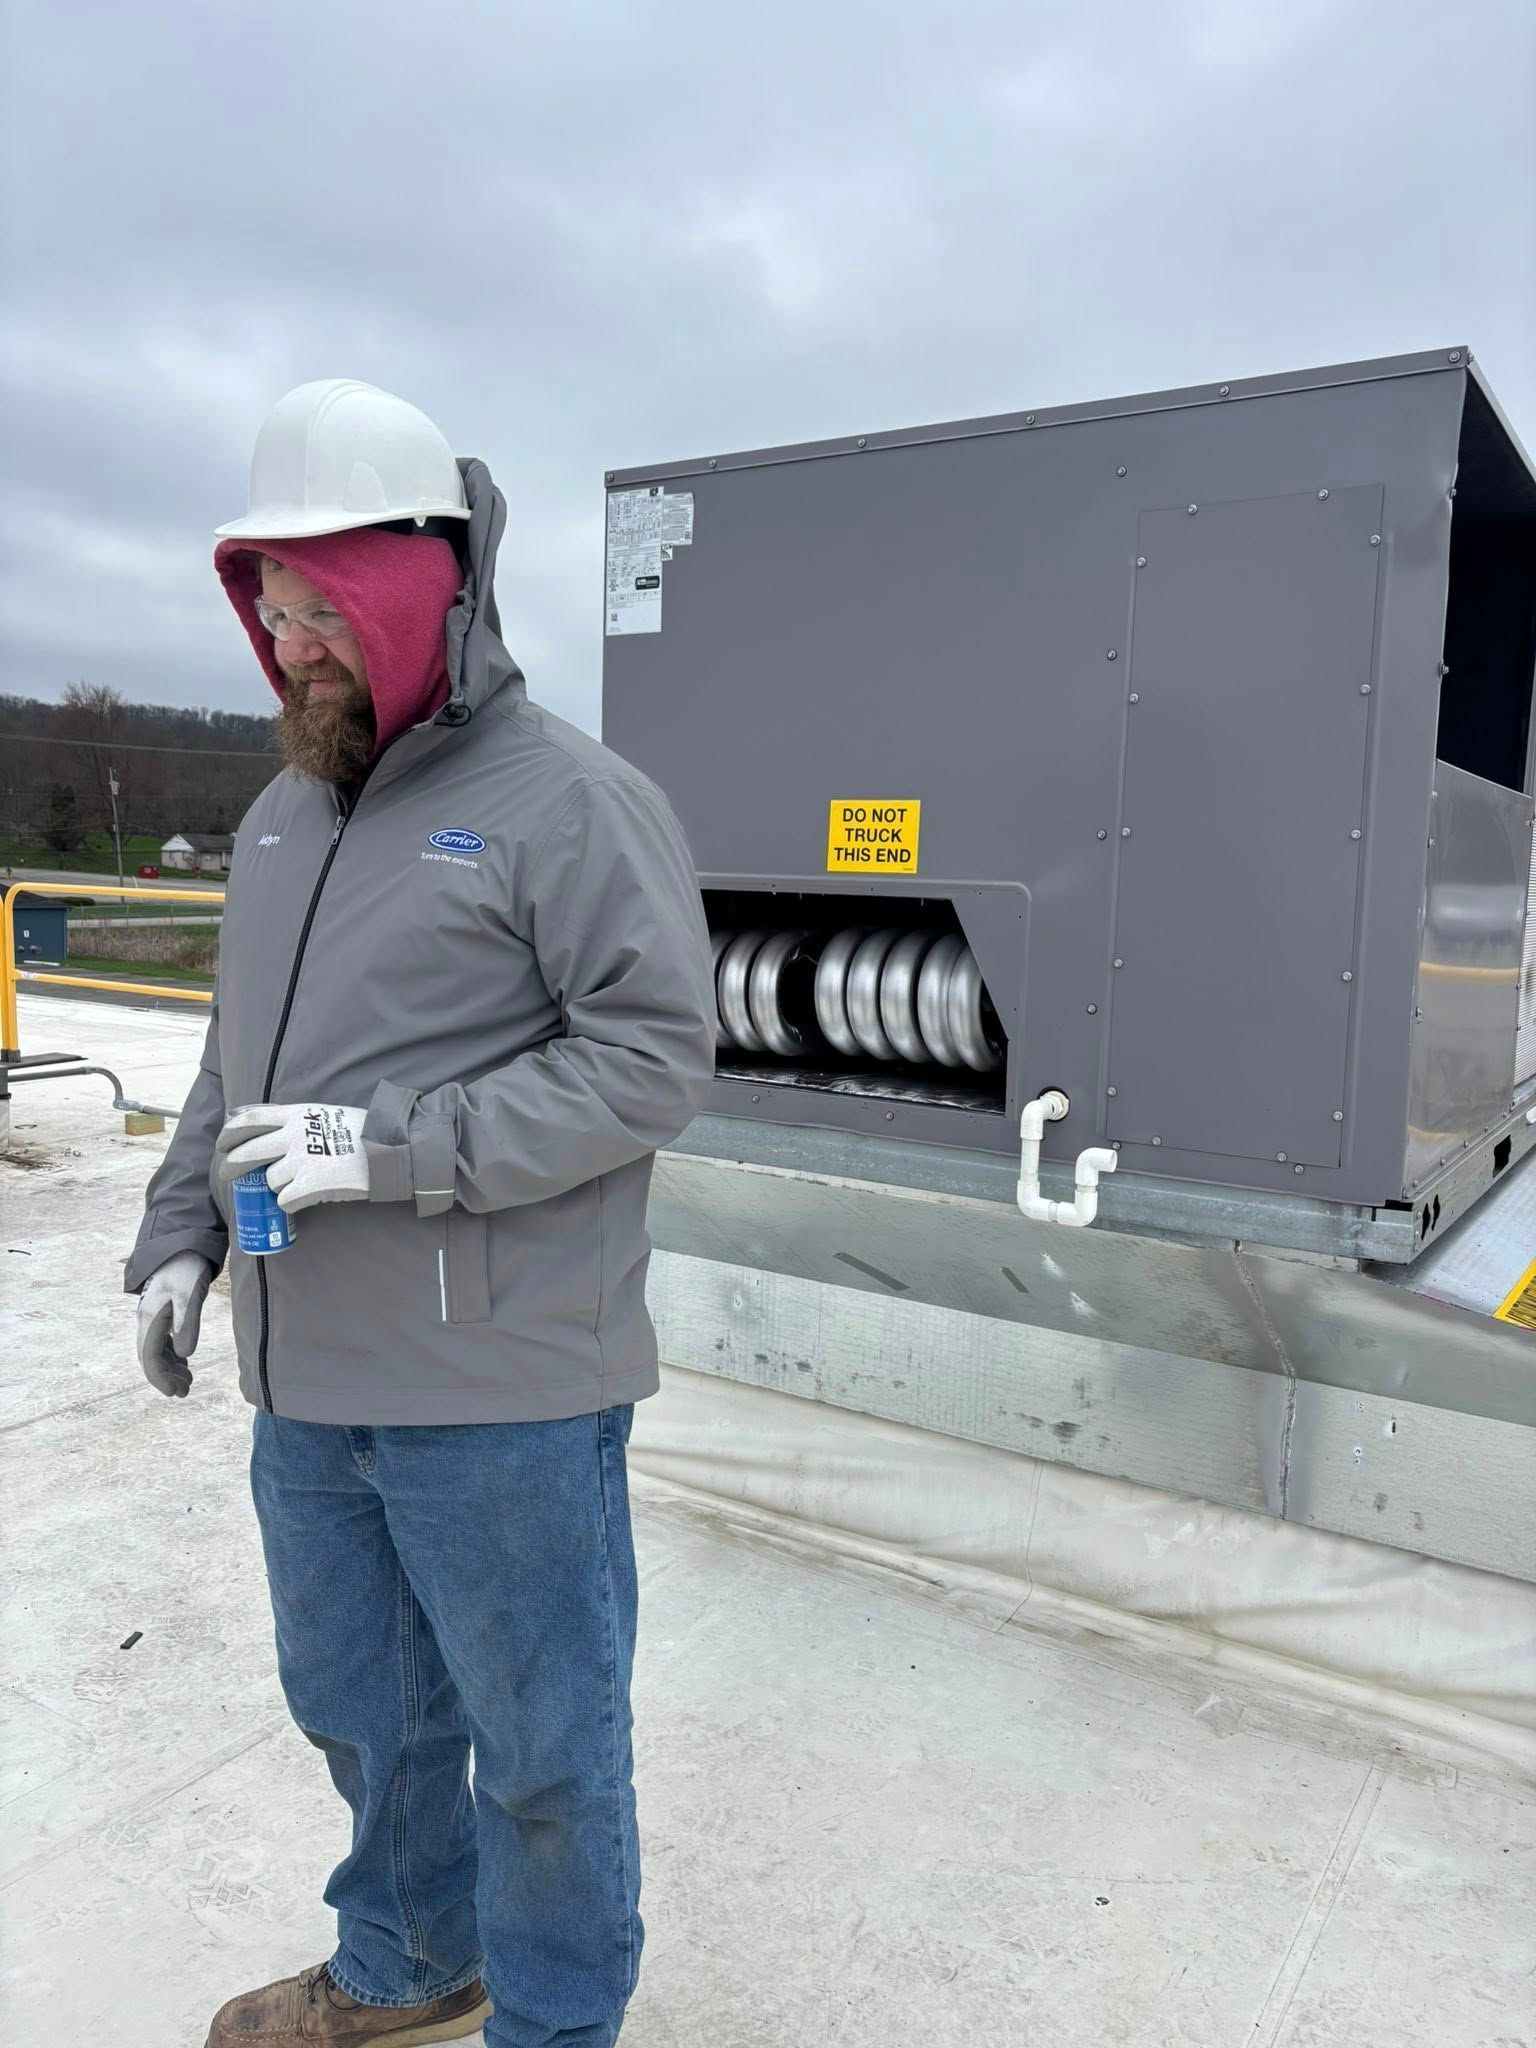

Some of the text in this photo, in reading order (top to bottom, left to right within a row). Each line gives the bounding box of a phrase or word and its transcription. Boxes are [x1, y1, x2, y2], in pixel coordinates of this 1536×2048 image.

[842, 808, 907, 823] DO NOT
[435, 833, 479, 847] Carrier
[845, 828, 902, 842] TRUCK
[420, 852, 433, 860] Turn
[452, 857, 478, 868] experts
[834, 848, 911, 862] THIS END
